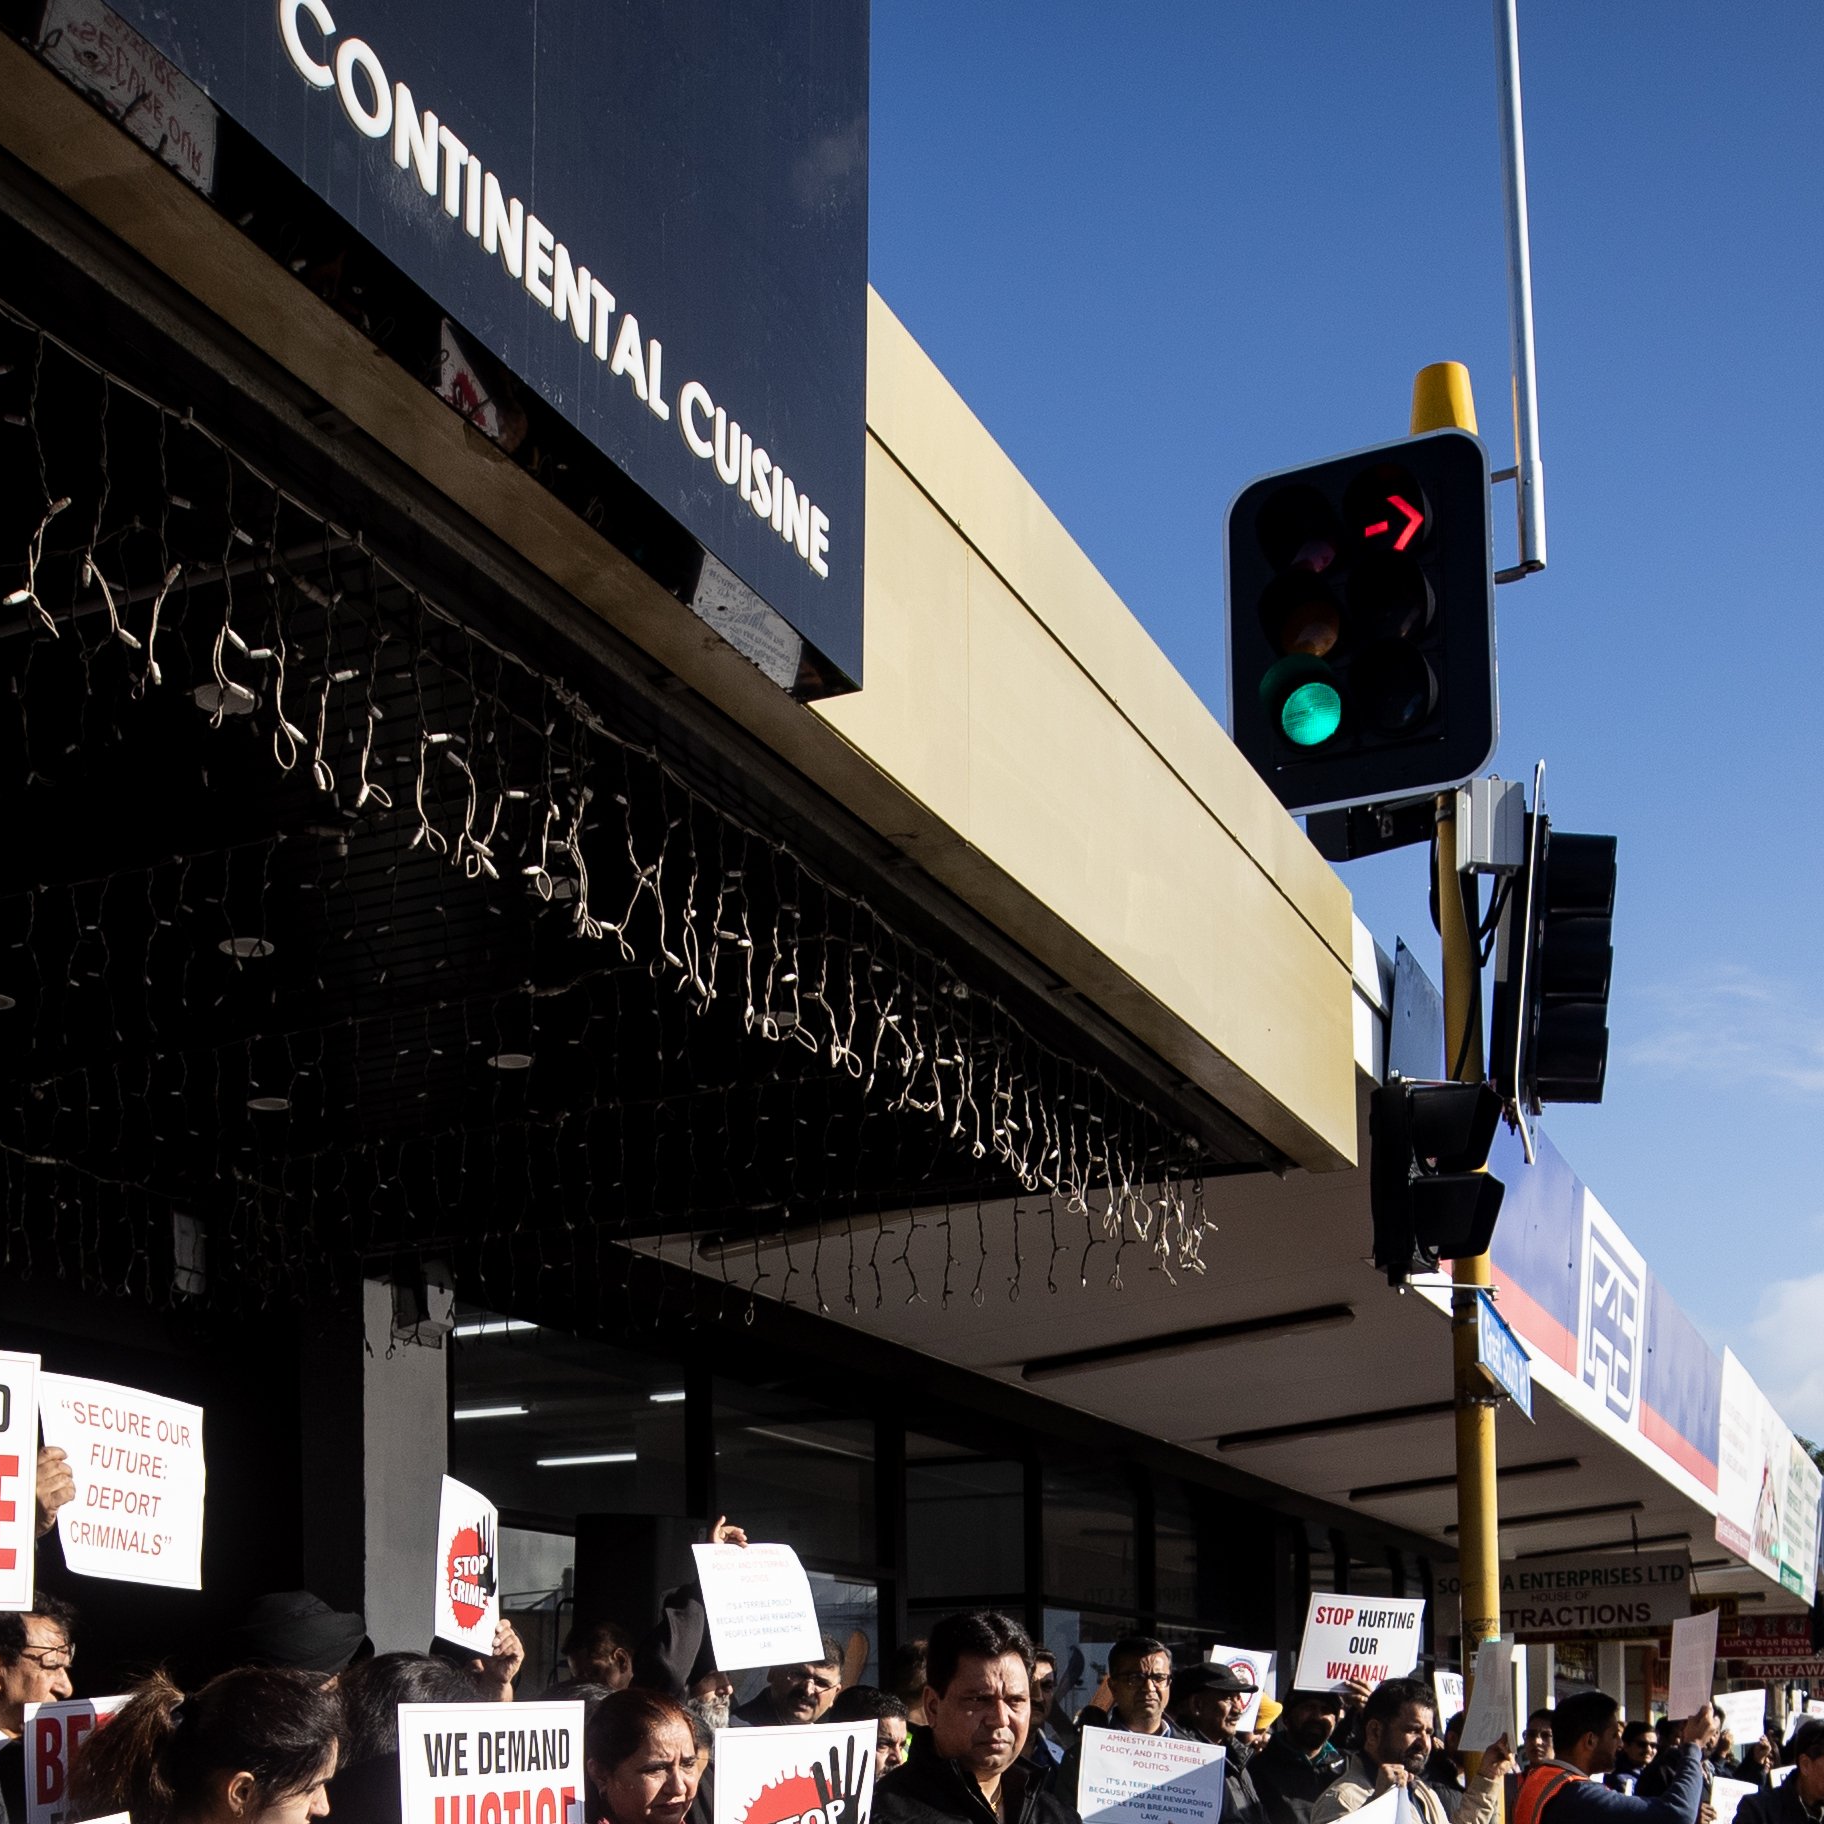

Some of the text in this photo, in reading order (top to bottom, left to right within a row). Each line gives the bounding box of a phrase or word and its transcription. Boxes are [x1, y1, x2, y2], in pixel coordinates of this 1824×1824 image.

[276, 0, 670, 421] CONTINENTAL
[678, 382, 831, 579] CUISINE
[157, 1421, 192, 1450] OUR
[89, 1442, 168, 1482] FUTURE:
[86, 1488, 162, 1519] DEPORT
[453, 1554, 489, 1578] STOP
[1519, 1564, 1685, 1591] ENTERPRISES LTD
[450, 1578, 488, 1610] CRIME
[1531, 1590, 1571, 1602] HOUSE
[1315, 1606, 1415, 1630] STOP HURTING
[1501, 1602, 1652, 1629] TRACTIONS
[1349, 1636, 1379, 1655] OUR
[423, 1728, 570, 1778] WE DEMAND
[1107, 1734, 1201, 1754] AMNESTY IS A TERRIBLE
[1133, 1749, 1152, 1758] AND
[1169, 1754, 1207, 1766] TERRIBLE
[1088, 1786, 1213, 1809] BECAUSE YOU ARE REWARDING
[1129, 1780, 1166, 1793] TERRIBLE
[1167, 1785, 1197, 1796] POLICY
[1096, 1797, 1205, 1818] PEOPLE FOR BREAKING THE
